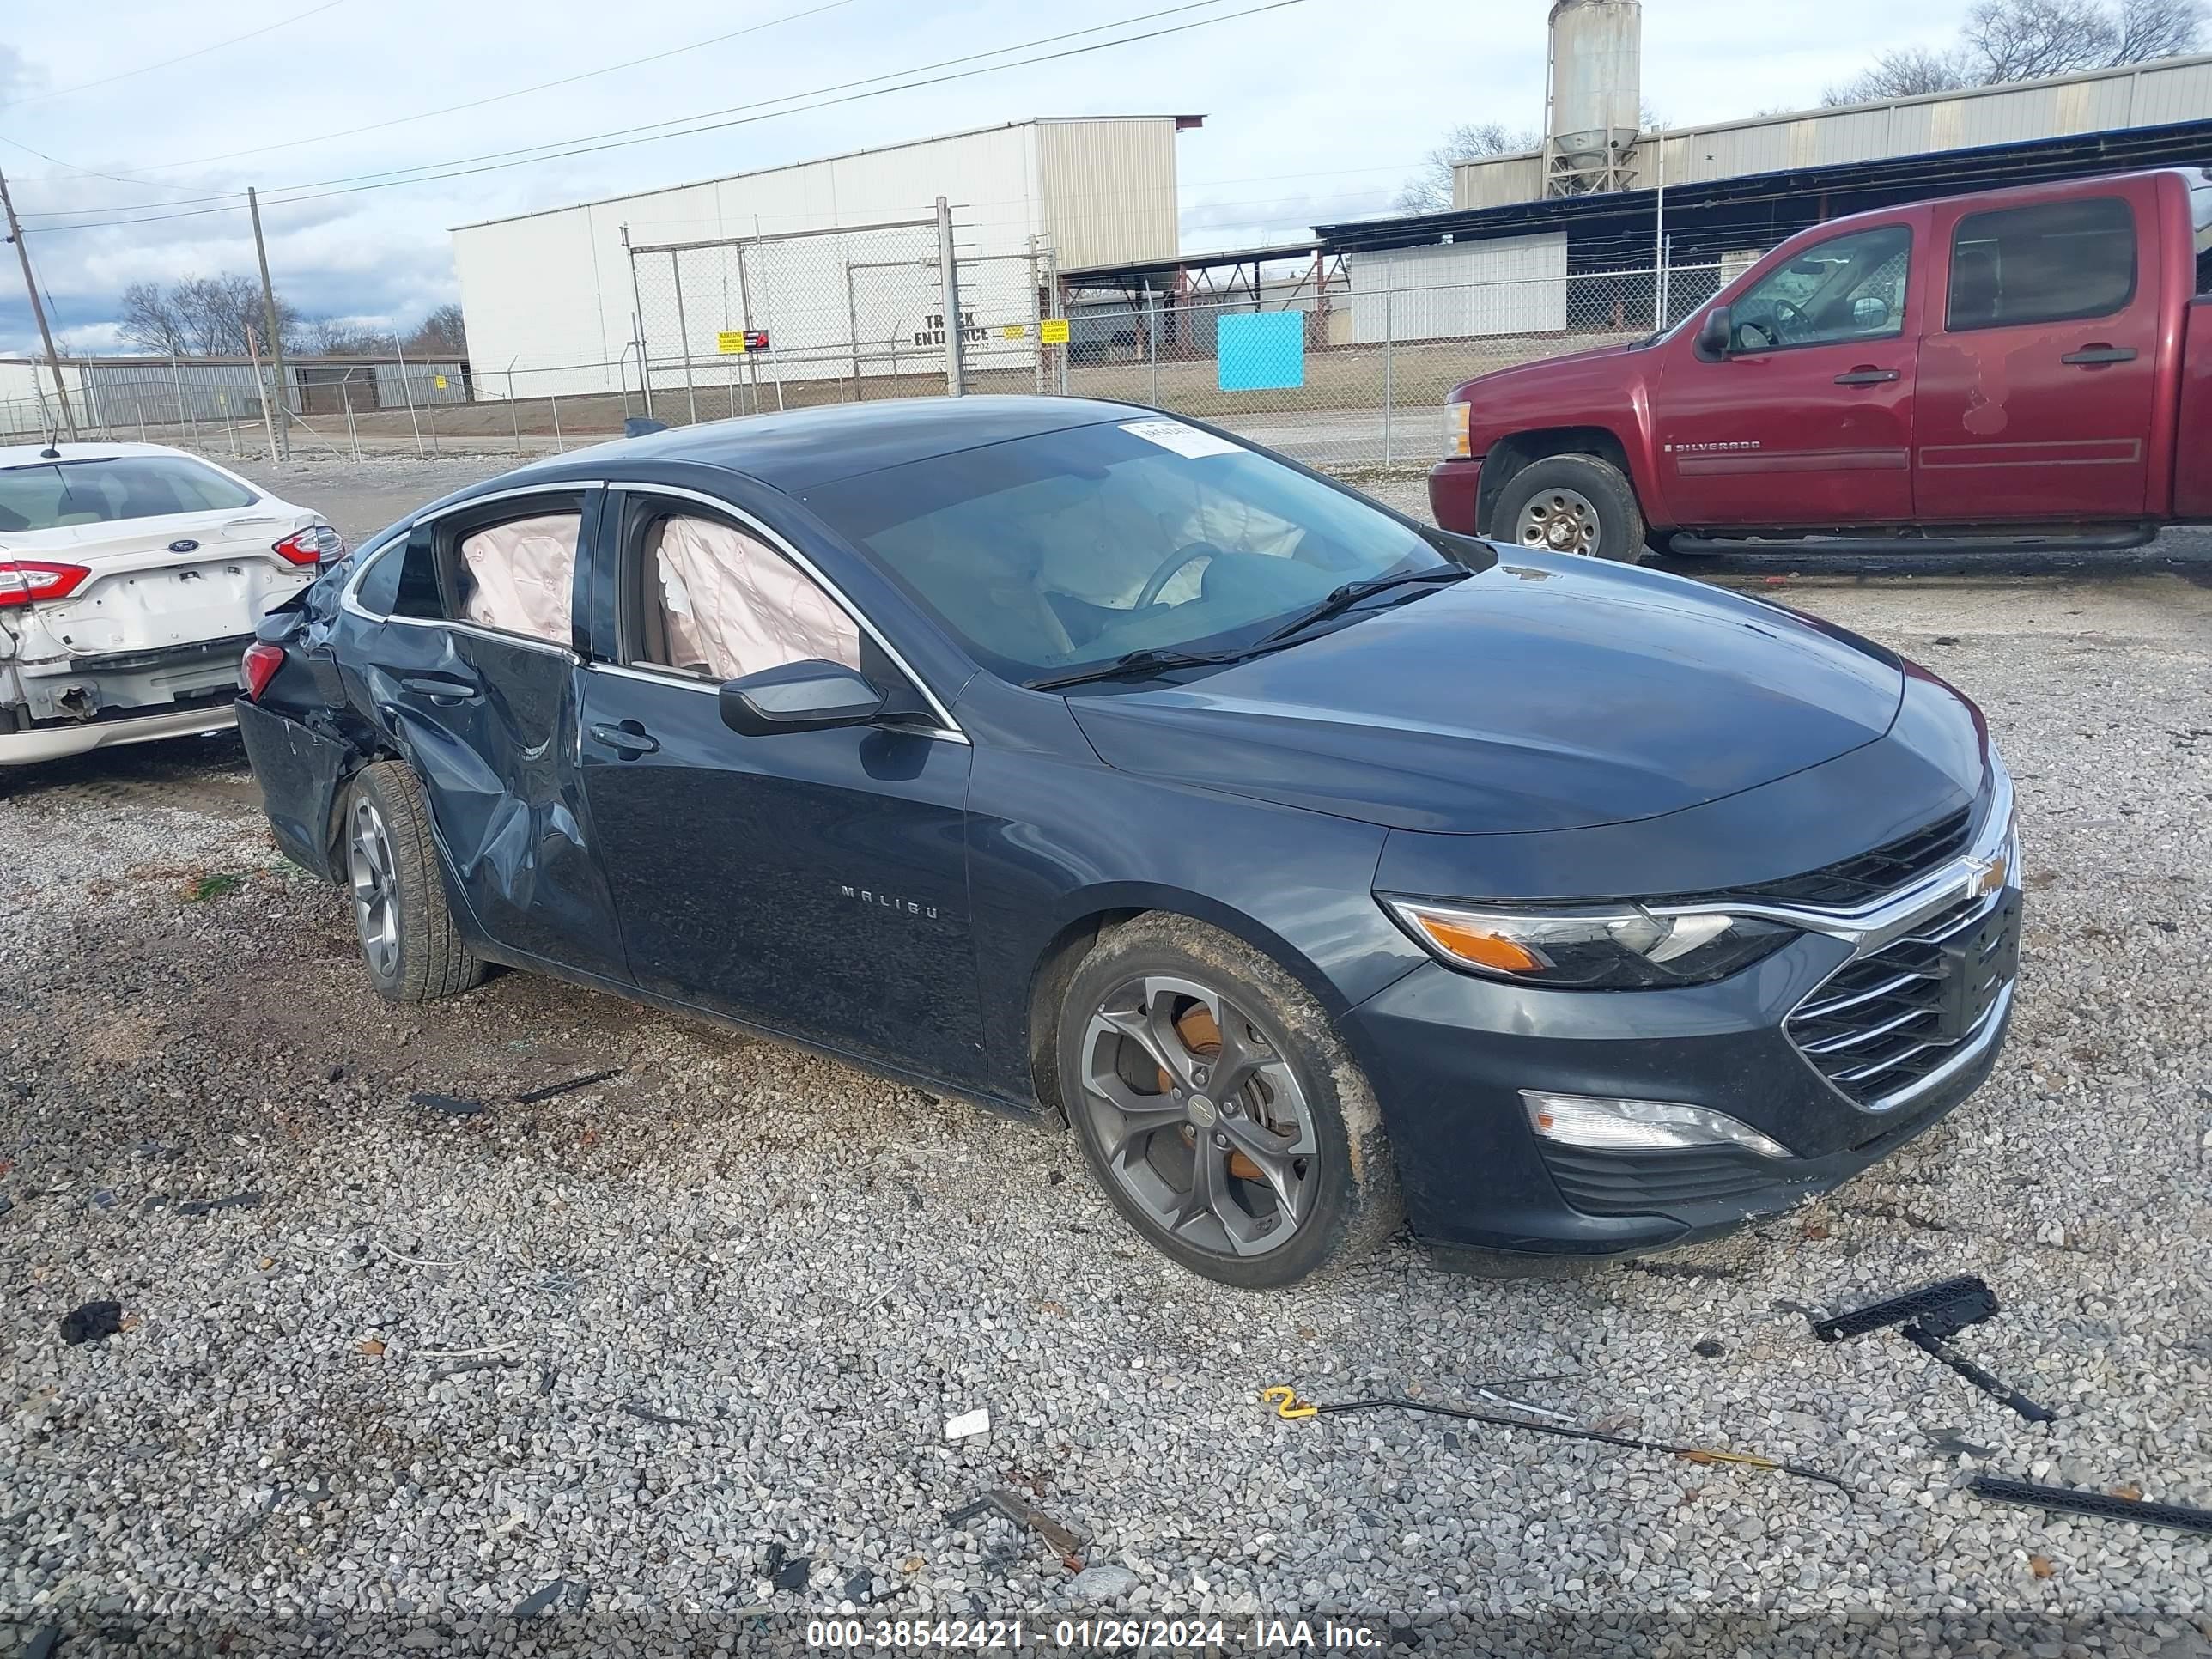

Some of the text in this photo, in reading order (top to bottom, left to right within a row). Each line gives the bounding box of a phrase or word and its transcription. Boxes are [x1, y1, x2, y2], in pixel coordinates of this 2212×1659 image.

[915, 328, 989, 346] ENTNCE
[1675, 441, 1761, 453] SILVERADO
[841, 885, 938, 920] MALIBU
